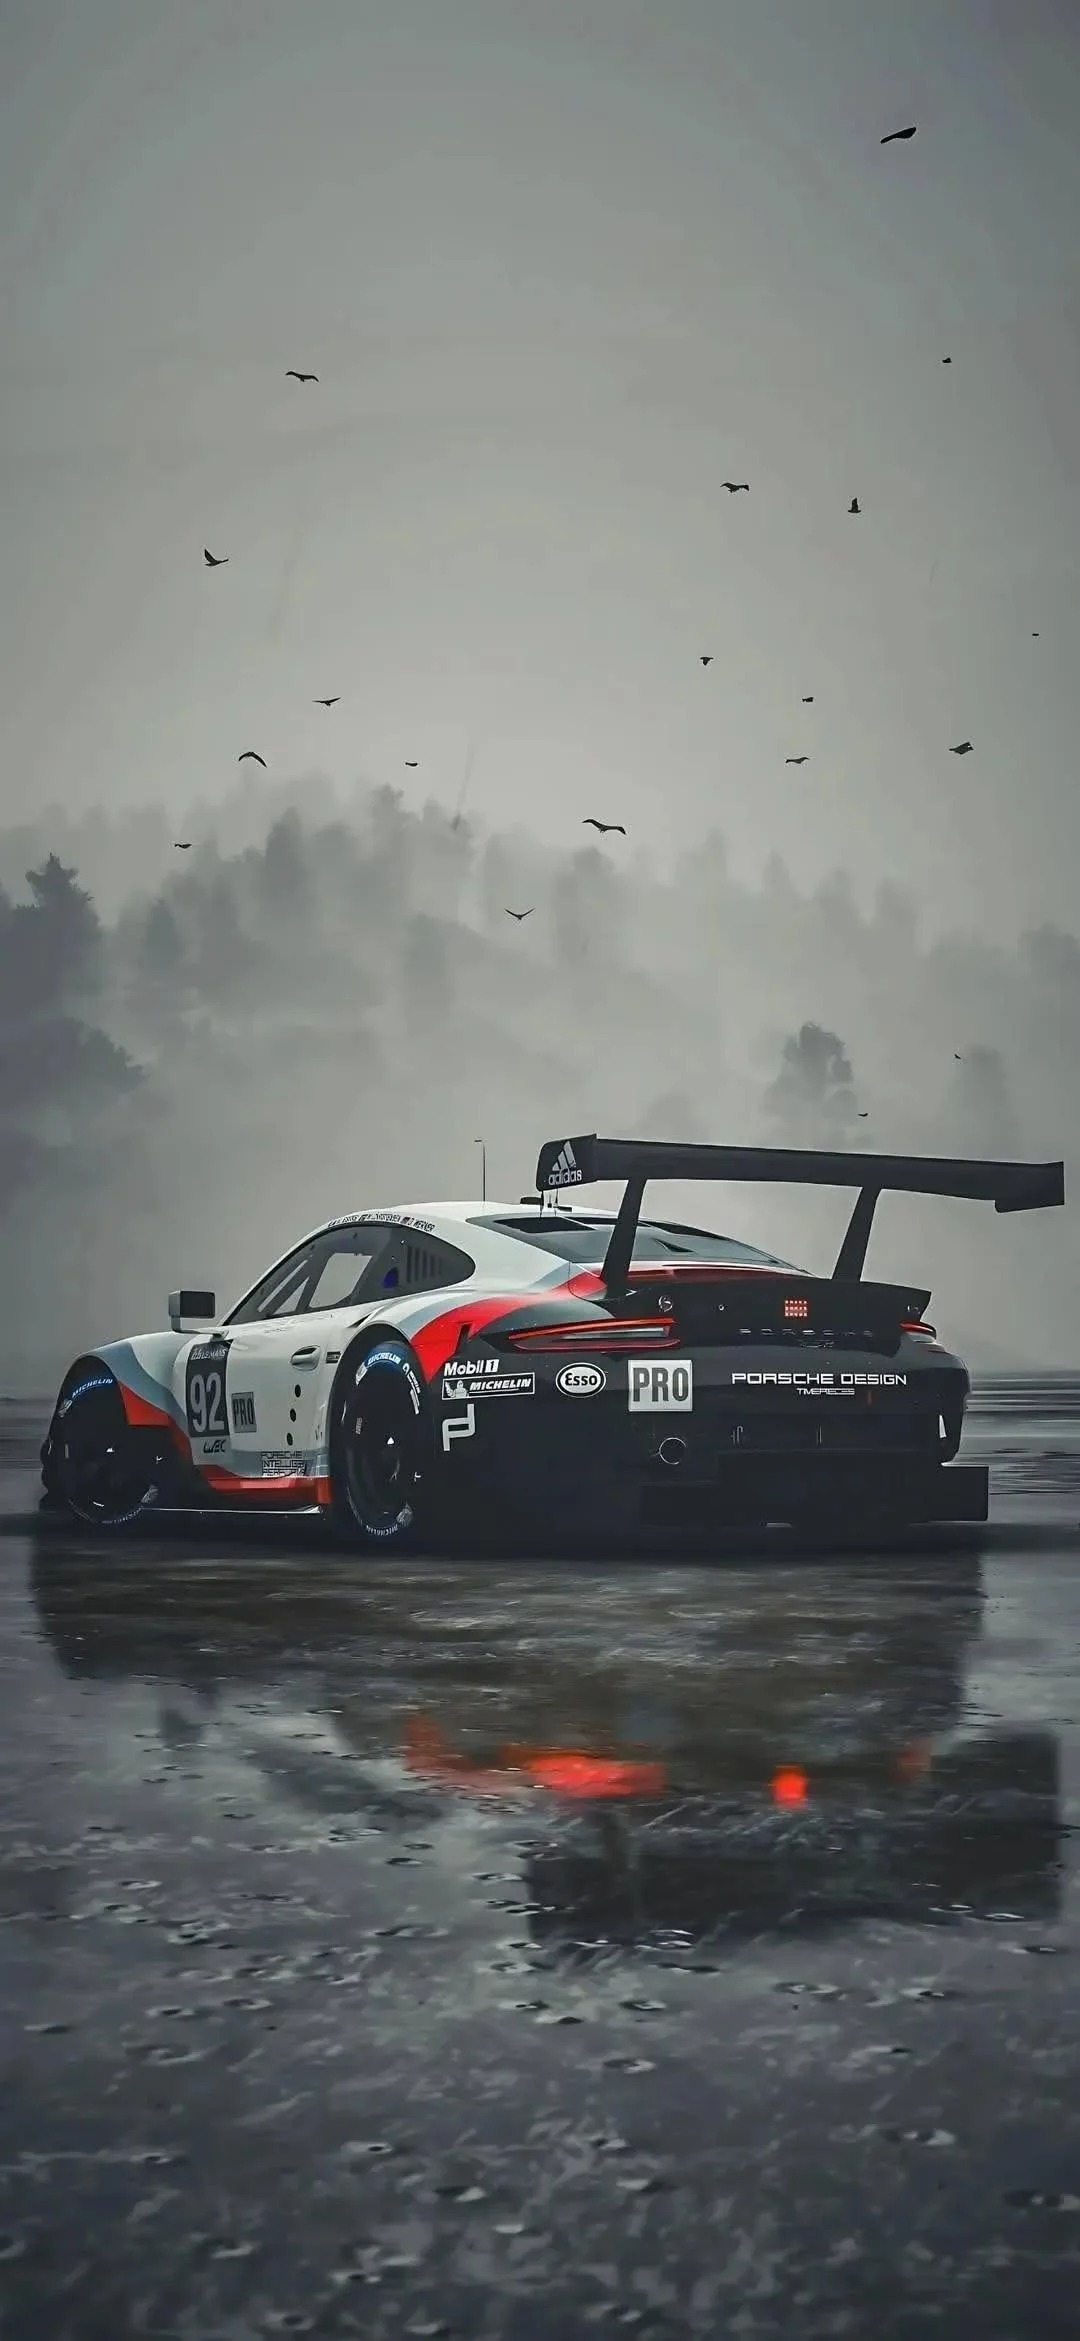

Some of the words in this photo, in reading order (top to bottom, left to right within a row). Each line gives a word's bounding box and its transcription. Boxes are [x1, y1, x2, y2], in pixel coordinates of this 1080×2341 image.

[548, 1167, 582, 1186] adidas
[444, 1360, 484, 1376] Mobil
[469, 1378, 532, 1391] MICHELIN
[565, 1372, 598, 1386] Esso
[632, 1367, 689, 1402] PRO
[731, 1372, 834, 1385] PORSCHE
[840, 1372, 907, 1385] DESIGN
[71, 1378, 113, 1399] MICHELIN
[190, 1372, 225, 1433] 92
[232, 1398, 254, 1427] PRO
